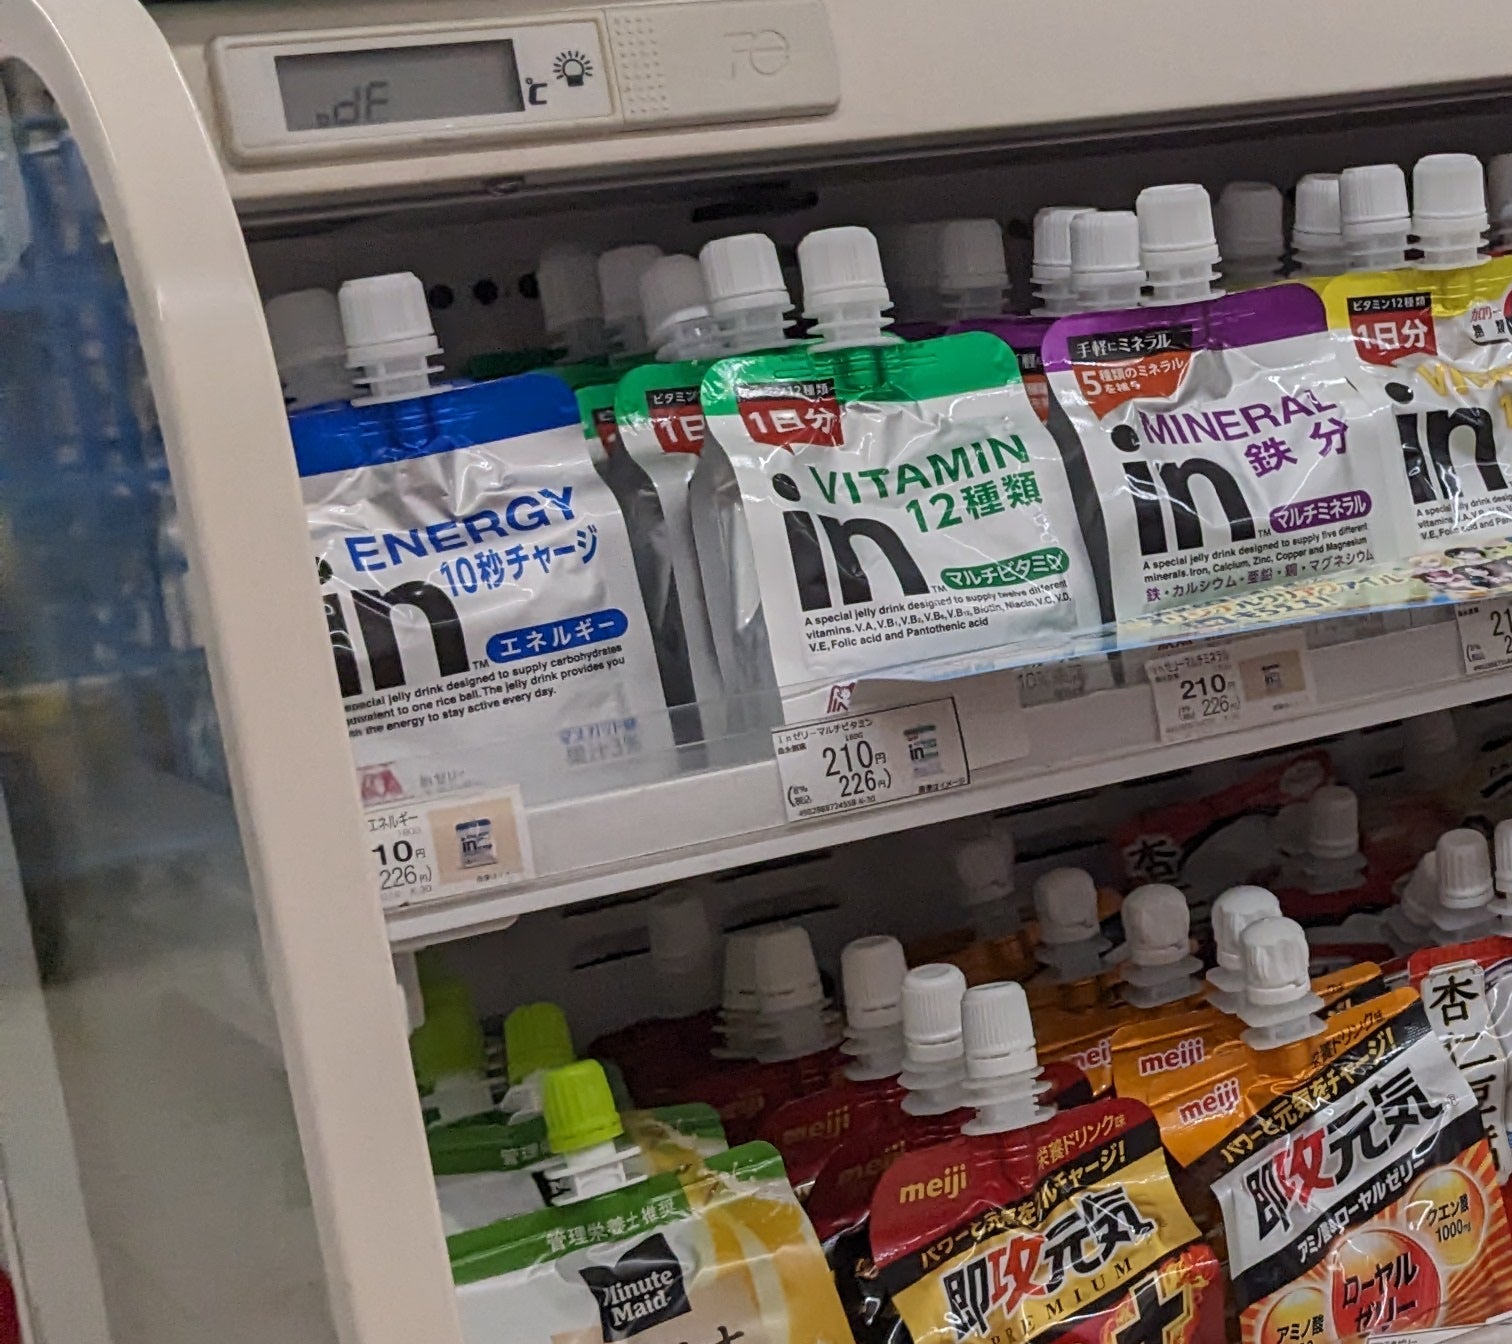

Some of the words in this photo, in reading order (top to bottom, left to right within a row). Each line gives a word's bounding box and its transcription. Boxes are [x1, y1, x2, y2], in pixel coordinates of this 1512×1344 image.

[808, 432, 1030, 506] VITAMIN
[904, 469, 1044, 534] 12種類
[343, 484, 576, 574] ENERGY
[772, 472, 931, 613] in
[499, 617, 616, 657] エネルギー
[415, 684, 443, 699] drink
[498, 670, 509, 679] to
[1138, 1039, 1204, 1078] meiji
[1179, 1078, 1241, 1126] meiji
[900, 1163, 968, 1205] meiji
